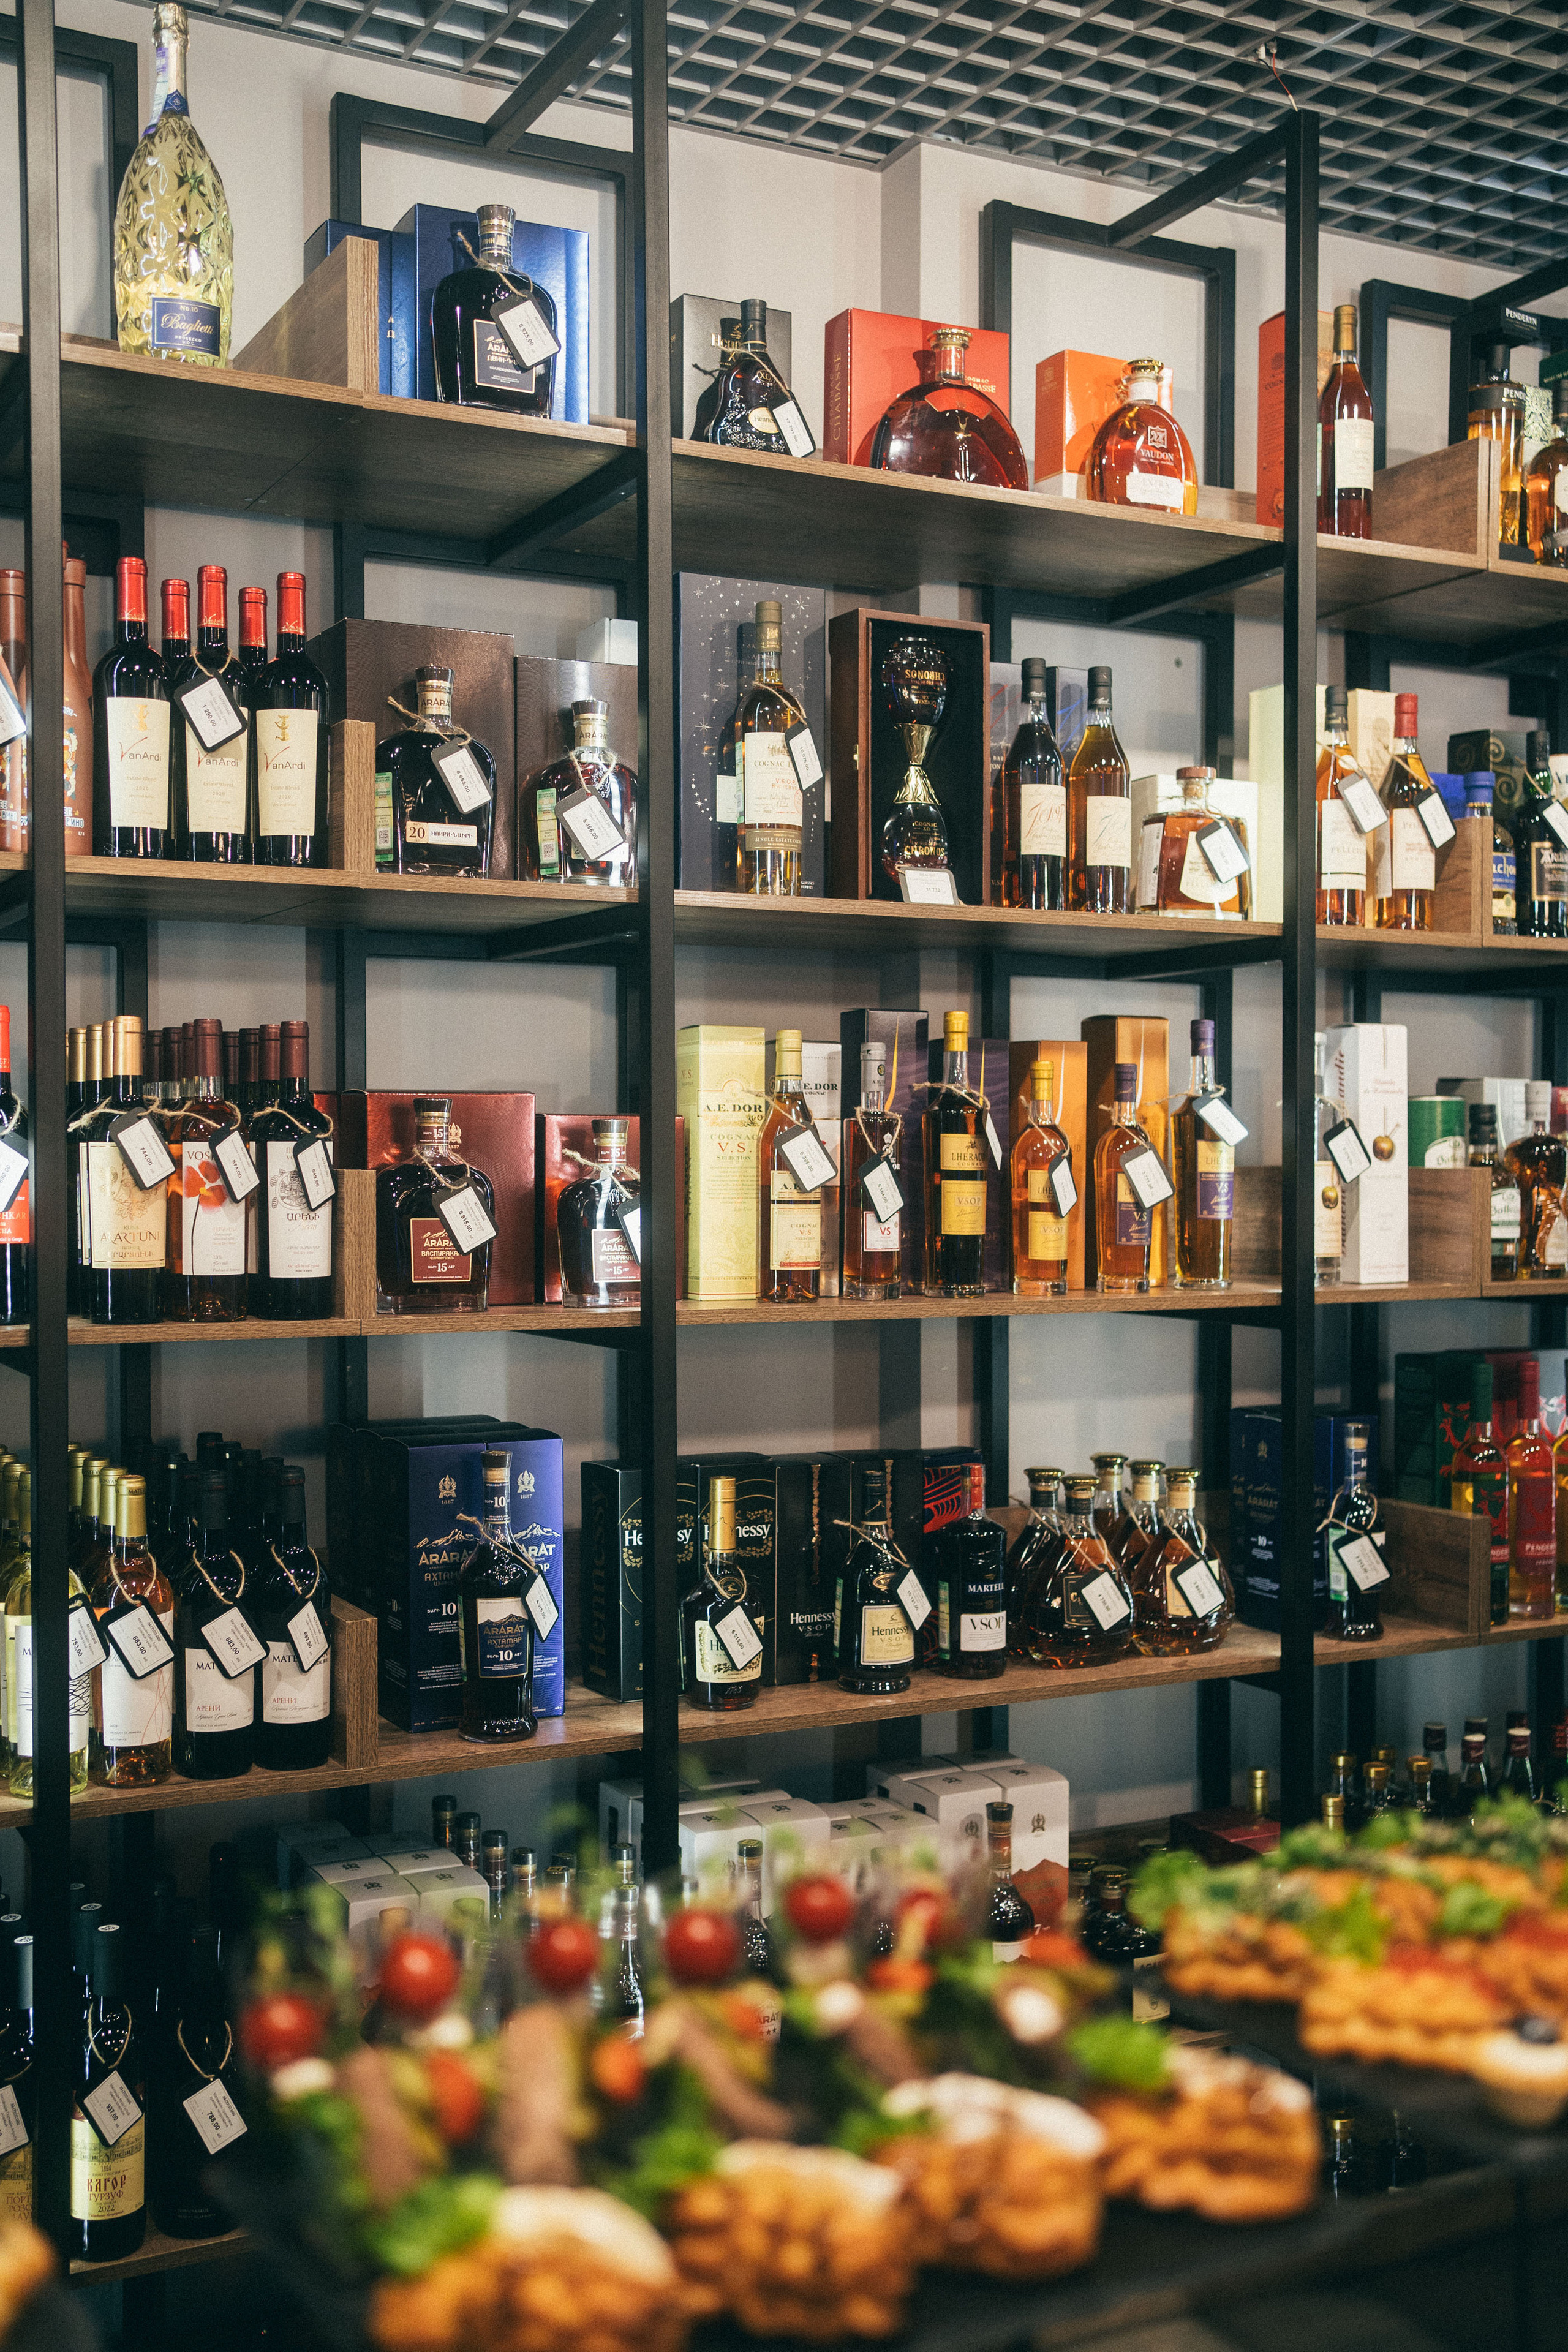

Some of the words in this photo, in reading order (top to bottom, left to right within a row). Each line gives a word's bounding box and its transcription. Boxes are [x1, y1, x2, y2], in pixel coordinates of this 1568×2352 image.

[1505, 307, 1537, 326] PENDERYN
[160, 313, 214, 337] Baglietti
[487, 342, 512, 354] ARA
[968, 383, 996, 393] ABASSE
[1503, 387, 1526, 400] PEND
[1140, 448, 1174, 461] VAUDON
[905, 669, 945, 681] CHRONOS
[421, 697, 451, 706] ARARA
[203, 709, 216, 727] 290,00
[119, 737, 162, 761] VanArdi
[196, 748, 238, 767] VanArdi
[264, 746, 306, 772] VanArdi
[409, 827, 425, 839] 20
[904, 845, 945, 857] CHRONOS
[704, 1104, 729, 1112] A.E.
[733, 1104, 763, 1113] DOR
[433, 1128, 443, 1137] 15
[140, 1147, 153, 1166] 744,00
[187, 1151, 214, 1160] VOS
[611, 1148, 620, 1157] 15
[461, 1215, 473, 1232] 915,00
[880, 1227, 891, 1235] VS
[424, 1236, 454, 1247] ARARA
[601, 1243, 629, 1252] ARARA
[437, 1262, 448, 1272] 15
[613, 1266, 622, 1275] 15
[494, 1496, 505, 1507] 10
[1257, 1535, 1267, 1547] 10
[424, 1573, 459, 1581] АХТАМ
[968, 1583, 1004, 1593] MARTELL
[442, 1602, 456, 1616] 10
[790, 1612, 835, 1624] Hennessy
[970, 1616, 1004, 1630] VSOP
[484, 1624, 525, 1635] ARARAT
[133, 1635, 146, 1654] 683,00
[226, 1637, 239, 1655] 683,00
[303, 1631, 312, 1649] 683,00
[72, 1637, 83, 1657] 753,00
[499, 1650, 513, 1661] 10
[496, 1869, 502, 1880] 3
[752, 1880, 758, 1891] 5
[1033, 1923, 1042, 1936] 7
[106, 2103, 118, 2121] 937,00
[207, 2111, 221, 2130] 788,00
[87, 2174, 127, 2192] КАГОР
[7, 2195, 31, 2204] ПОРТ
[89, 2190, 124, 2202] ГУРЗУФ
